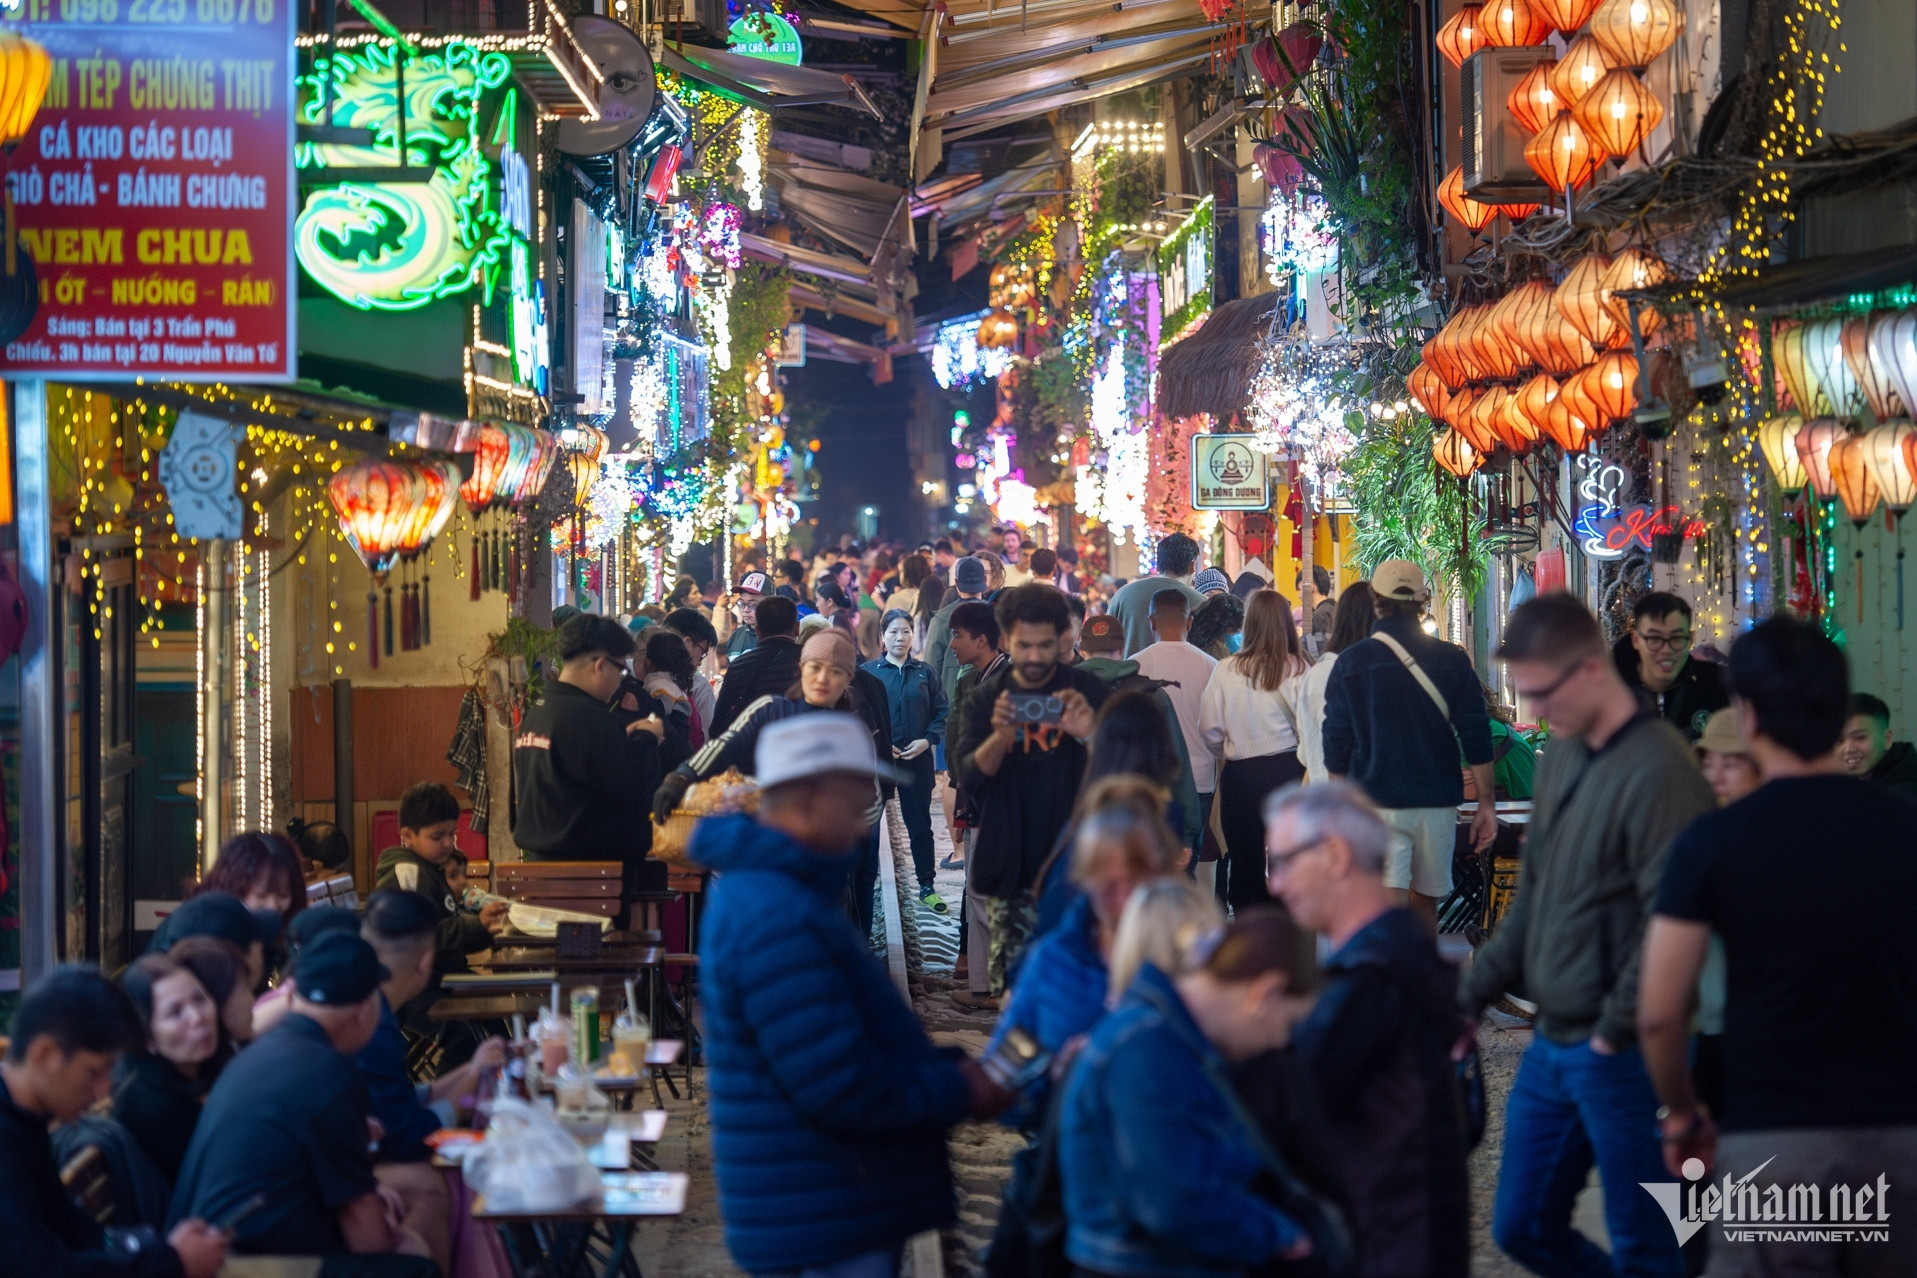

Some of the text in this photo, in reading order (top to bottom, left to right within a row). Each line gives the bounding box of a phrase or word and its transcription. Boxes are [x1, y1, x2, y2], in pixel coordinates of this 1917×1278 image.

[222, 59, 274, 118] THỊT
[39, 120, 233, 167] CÁ KHO CÁC LOẠI
[49, 161, 96, 206] CHẢ
[117, 166, 180, 207] BÁNH
[20, 229, 253, 265] NEM CHUA
[112, 272, 196, 305] NƯỚNG
[47, 315, 91, 338] Sáng:
[94, 315, 125, 336] Bán
[128, 317, 150, 341] tại
[153, 317, 163, 337] 3
[204, 317, 236, 337] Phú
[59, 342, 79, 362] 3h
[82, 342, 112, 362] bán
[115, 342, 136, 367] tại
[140, 342, 159, 362] 20
[1201, 488, 1211, 498] GA
